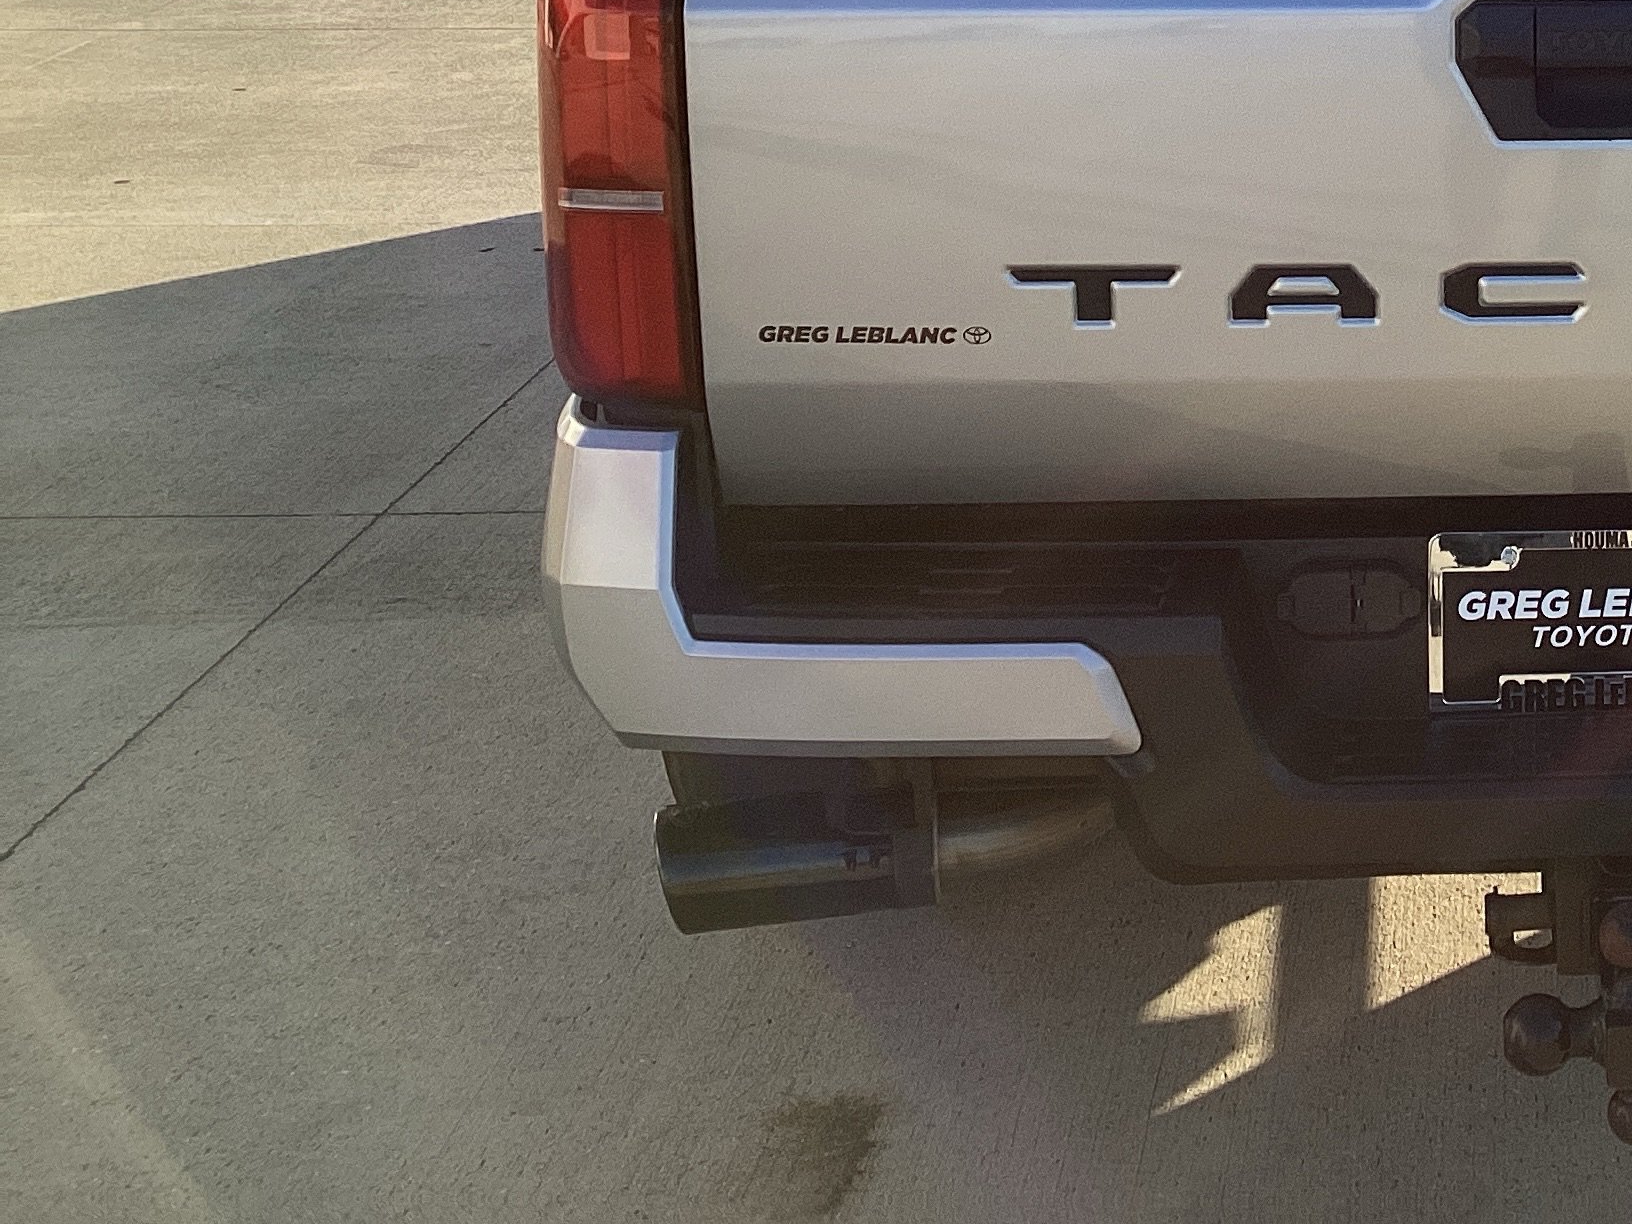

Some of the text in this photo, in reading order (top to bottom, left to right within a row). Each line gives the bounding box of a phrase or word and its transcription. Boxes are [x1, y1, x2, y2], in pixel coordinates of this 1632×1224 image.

[758, 325, 959, 345] GREG LEBLANC
[1458, 589, 1570, 621] GREG
[1500, 677, 1586, 712] GREG
